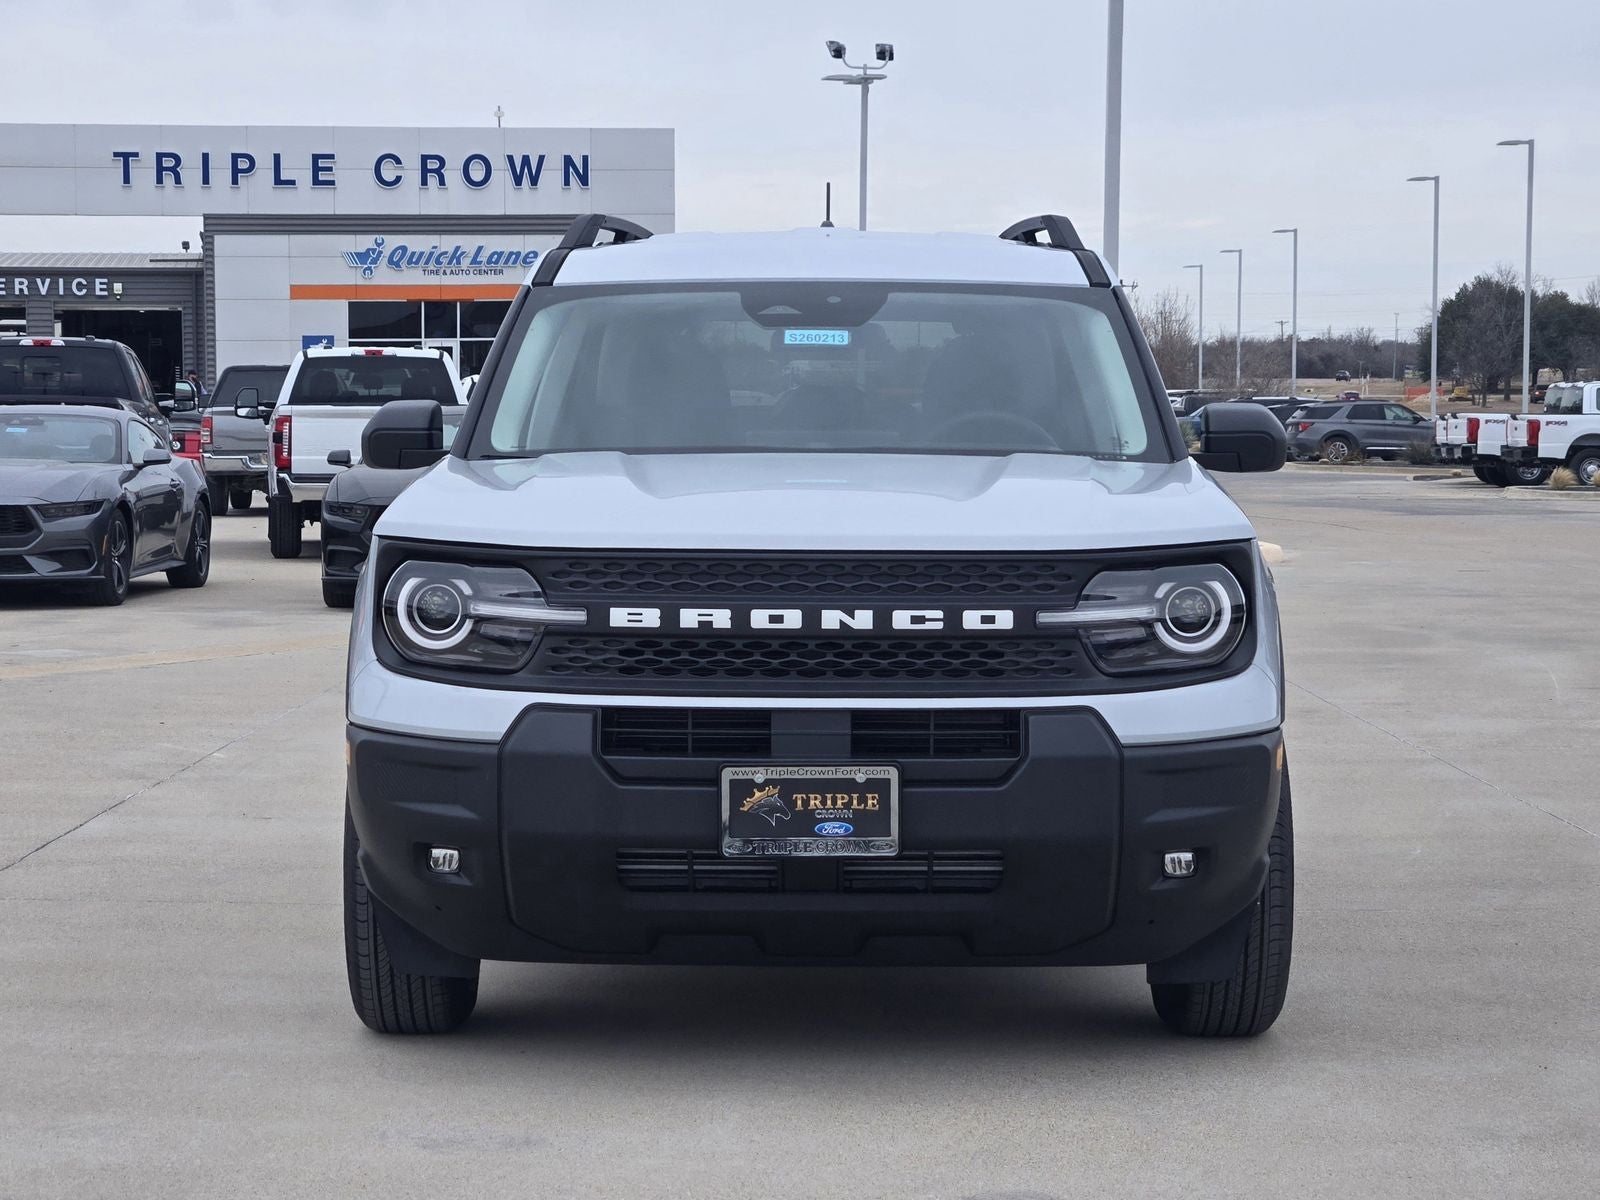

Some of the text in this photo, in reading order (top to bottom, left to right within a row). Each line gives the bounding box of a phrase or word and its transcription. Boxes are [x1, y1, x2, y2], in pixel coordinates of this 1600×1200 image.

[112, 151, 590, 189] TRIPLE CROWN
[387, 244, 539, 271] Quick Lane
[789, 333, 845, 343] S260213
[609, 607, 1014, 630] BRONCO
[731, 767, 890, 777] www.TripleCrownFord.com
[792, 793, 880, 811] TRIPLE
[814, 809, 853, 819] CROWN
[820, 823, 847, 835] Ford
[752, 840, 813, 855] TRIPLE
[815, 840, 869, 854] CROWN
